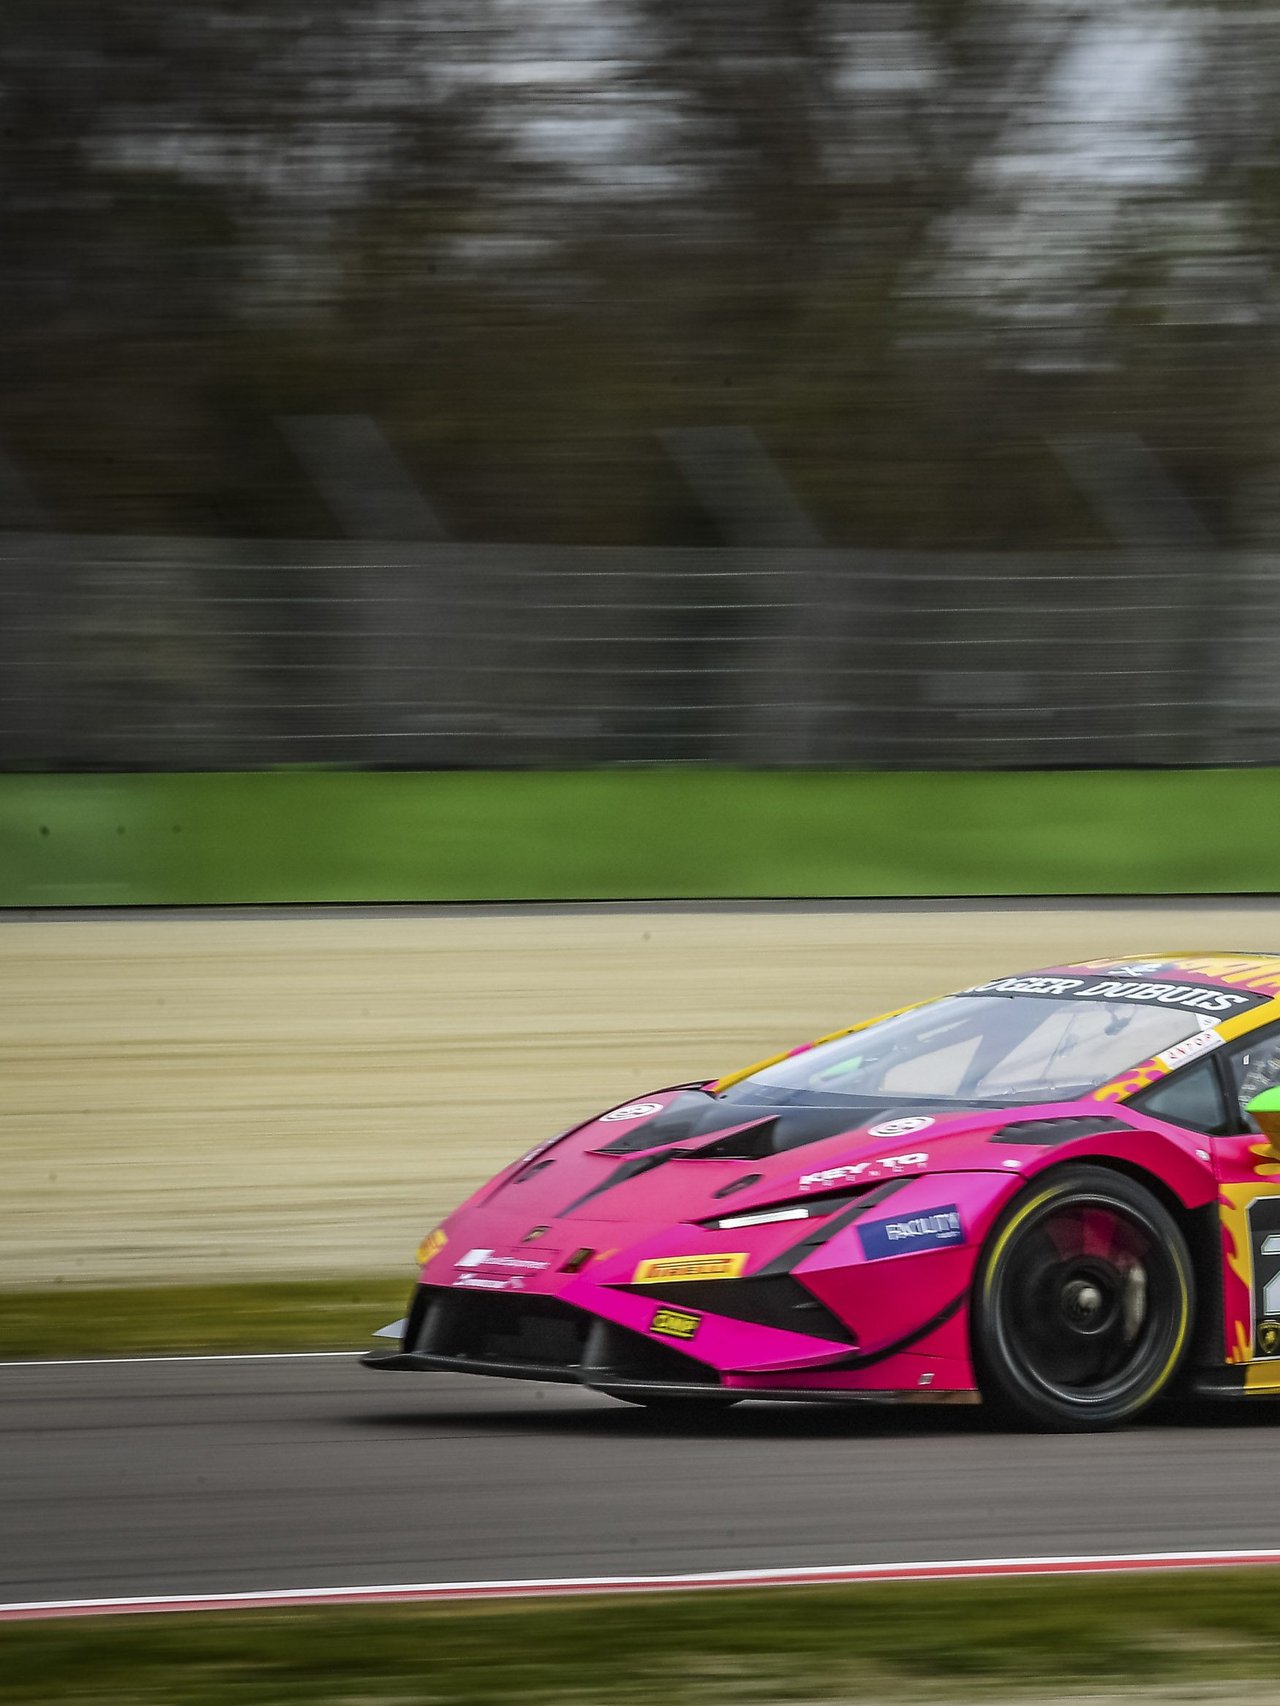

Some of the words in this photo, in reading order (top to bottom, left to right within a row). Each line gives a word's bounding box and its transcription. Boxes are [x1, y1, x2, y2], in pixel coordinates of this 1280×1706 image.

[963, 976, 1085, 996] OGER
[1074, 981, 1249, 1012] DUBUIS
[799, 1161, 873, 1185] KEY
[875, 1152, 929, 1168] TO
